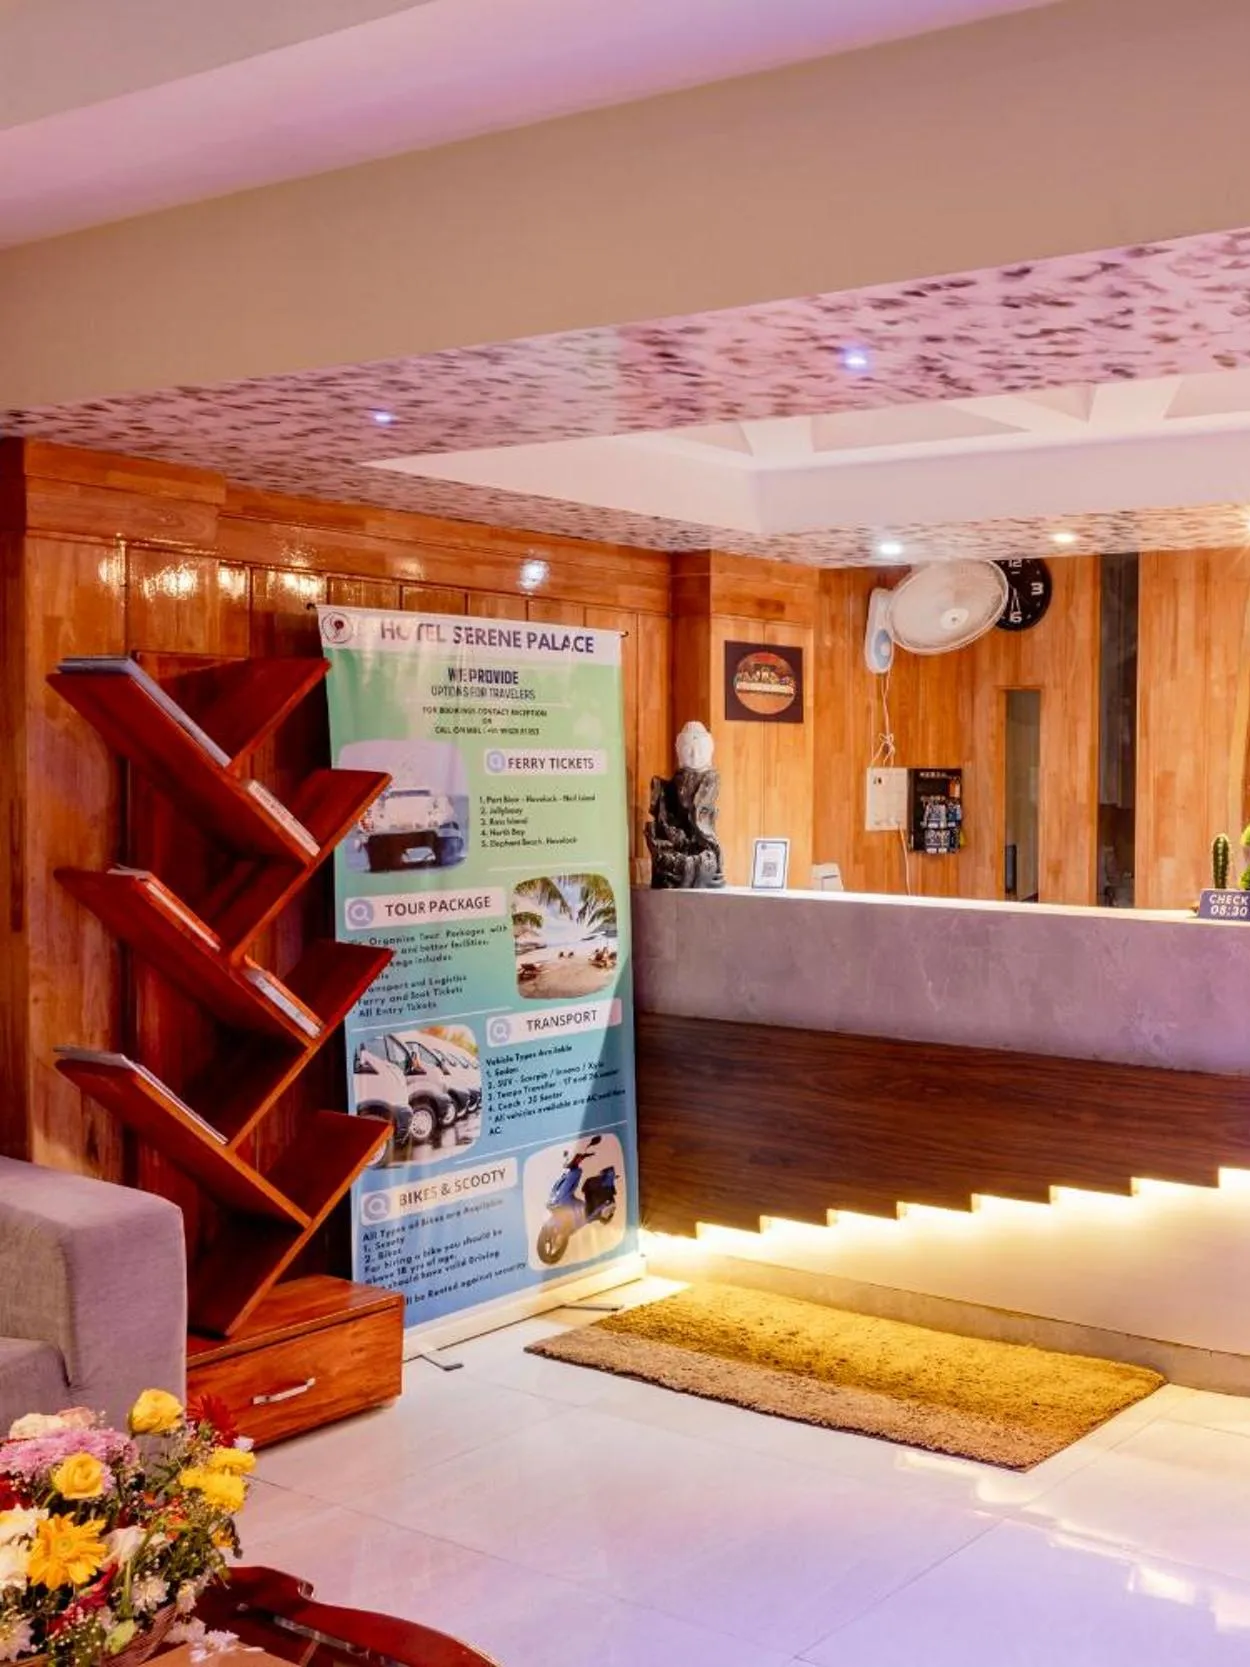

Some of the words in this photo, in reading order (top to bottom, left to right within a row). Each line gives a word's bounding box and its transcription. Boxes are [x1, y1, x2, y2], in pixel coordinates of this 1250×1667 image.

[1030, 582, 1044, 596] 3
[1010, 611, 1022, 623] 6
[453, 626, 521, 648] SERENE
[526, 631, 594, 653] PALACE
[469, 668, 518, 684] PROVIDE
[431, 686, 469, 698] OPTIONS
[470, 687, 487, 698] FOR
[489, 688, 536, 700] TRAVELERS
[508, 758, 546, 769] FERRY
[549, 758, 594, 769] TICKETS
[385, 902, 426, 917] TOUR
[429, 896, 491, 912] PACKAGE
[1209, 894, 1248, 906] CHECK
[1210, 905, 1248, 916] 08:30
[389, 993, 408, 1002] and
[359, 1008, 372, 1017] All
[376, 1006, 403, 1016] Entry
[526, 1010, 598, 1032] TRANSPORT
[399, 1185, 438, 1206] BIKES
[440, 1183, 451, 1196] &
[454, 1168, 507, 1193] SCOOTY
[363, 1231, 377, 1242] All
